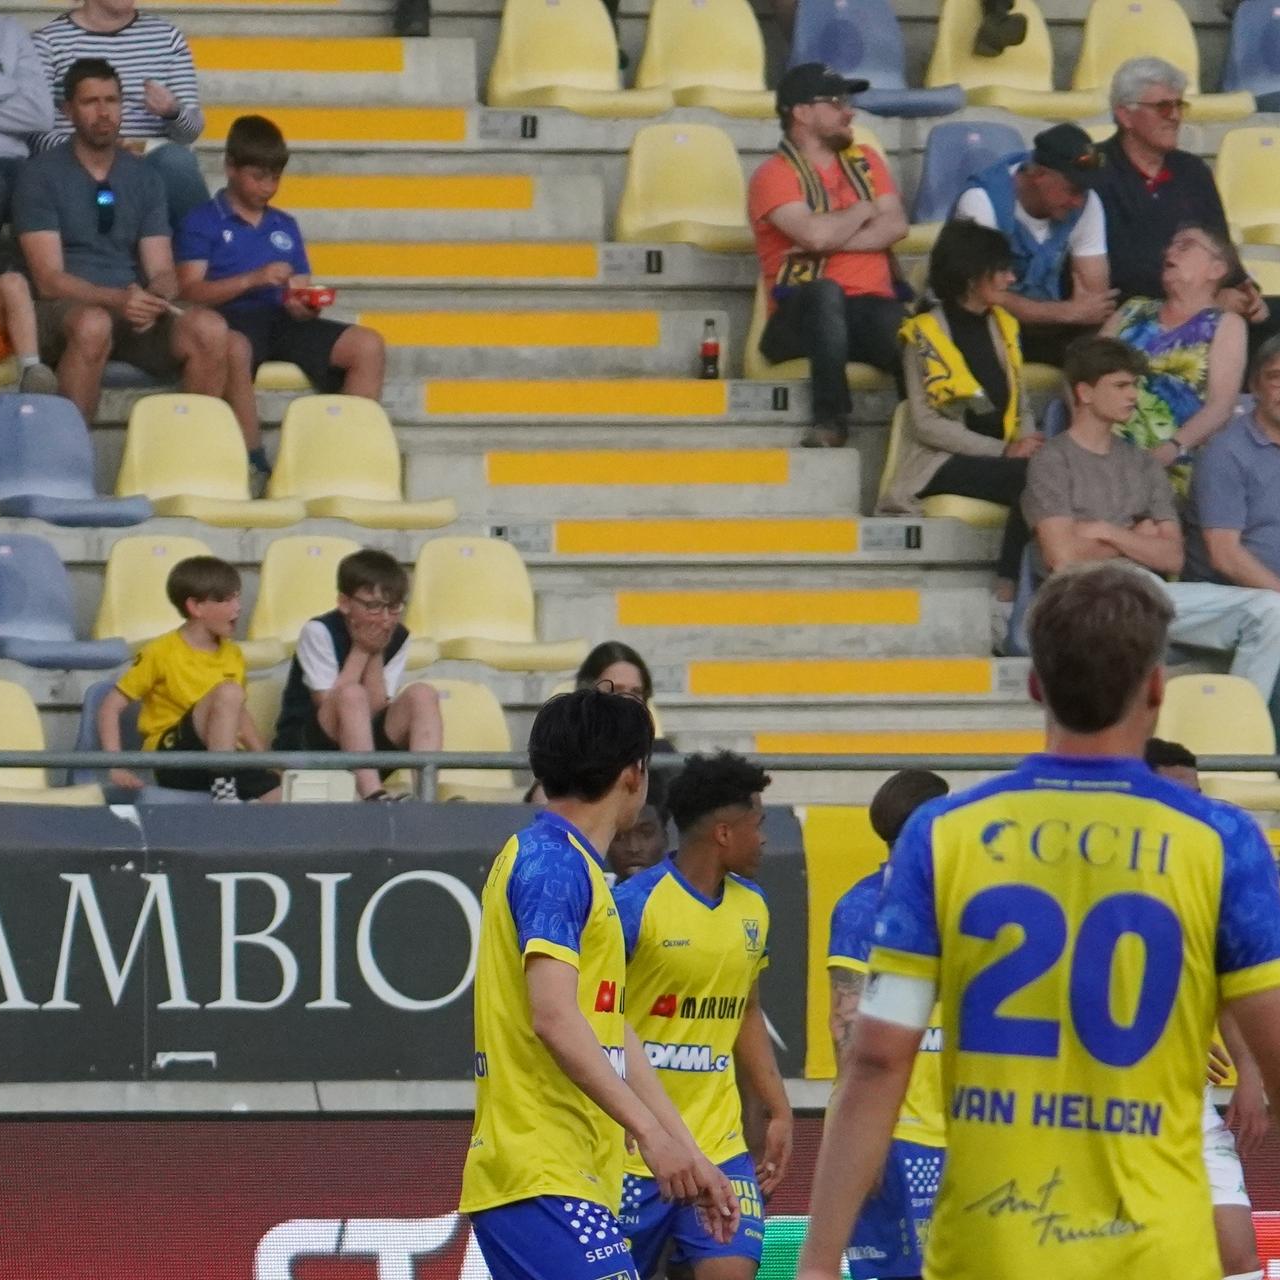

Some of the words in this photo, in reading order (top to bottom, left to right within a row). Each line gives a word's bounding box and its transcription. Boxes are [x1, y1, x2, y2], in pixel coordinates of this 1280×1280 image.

[958, 883, 1184, 1068] 20
[947, 1085, 1015, 1124] VAN
[1031, 1091, 1163, 1137] HELDEN
